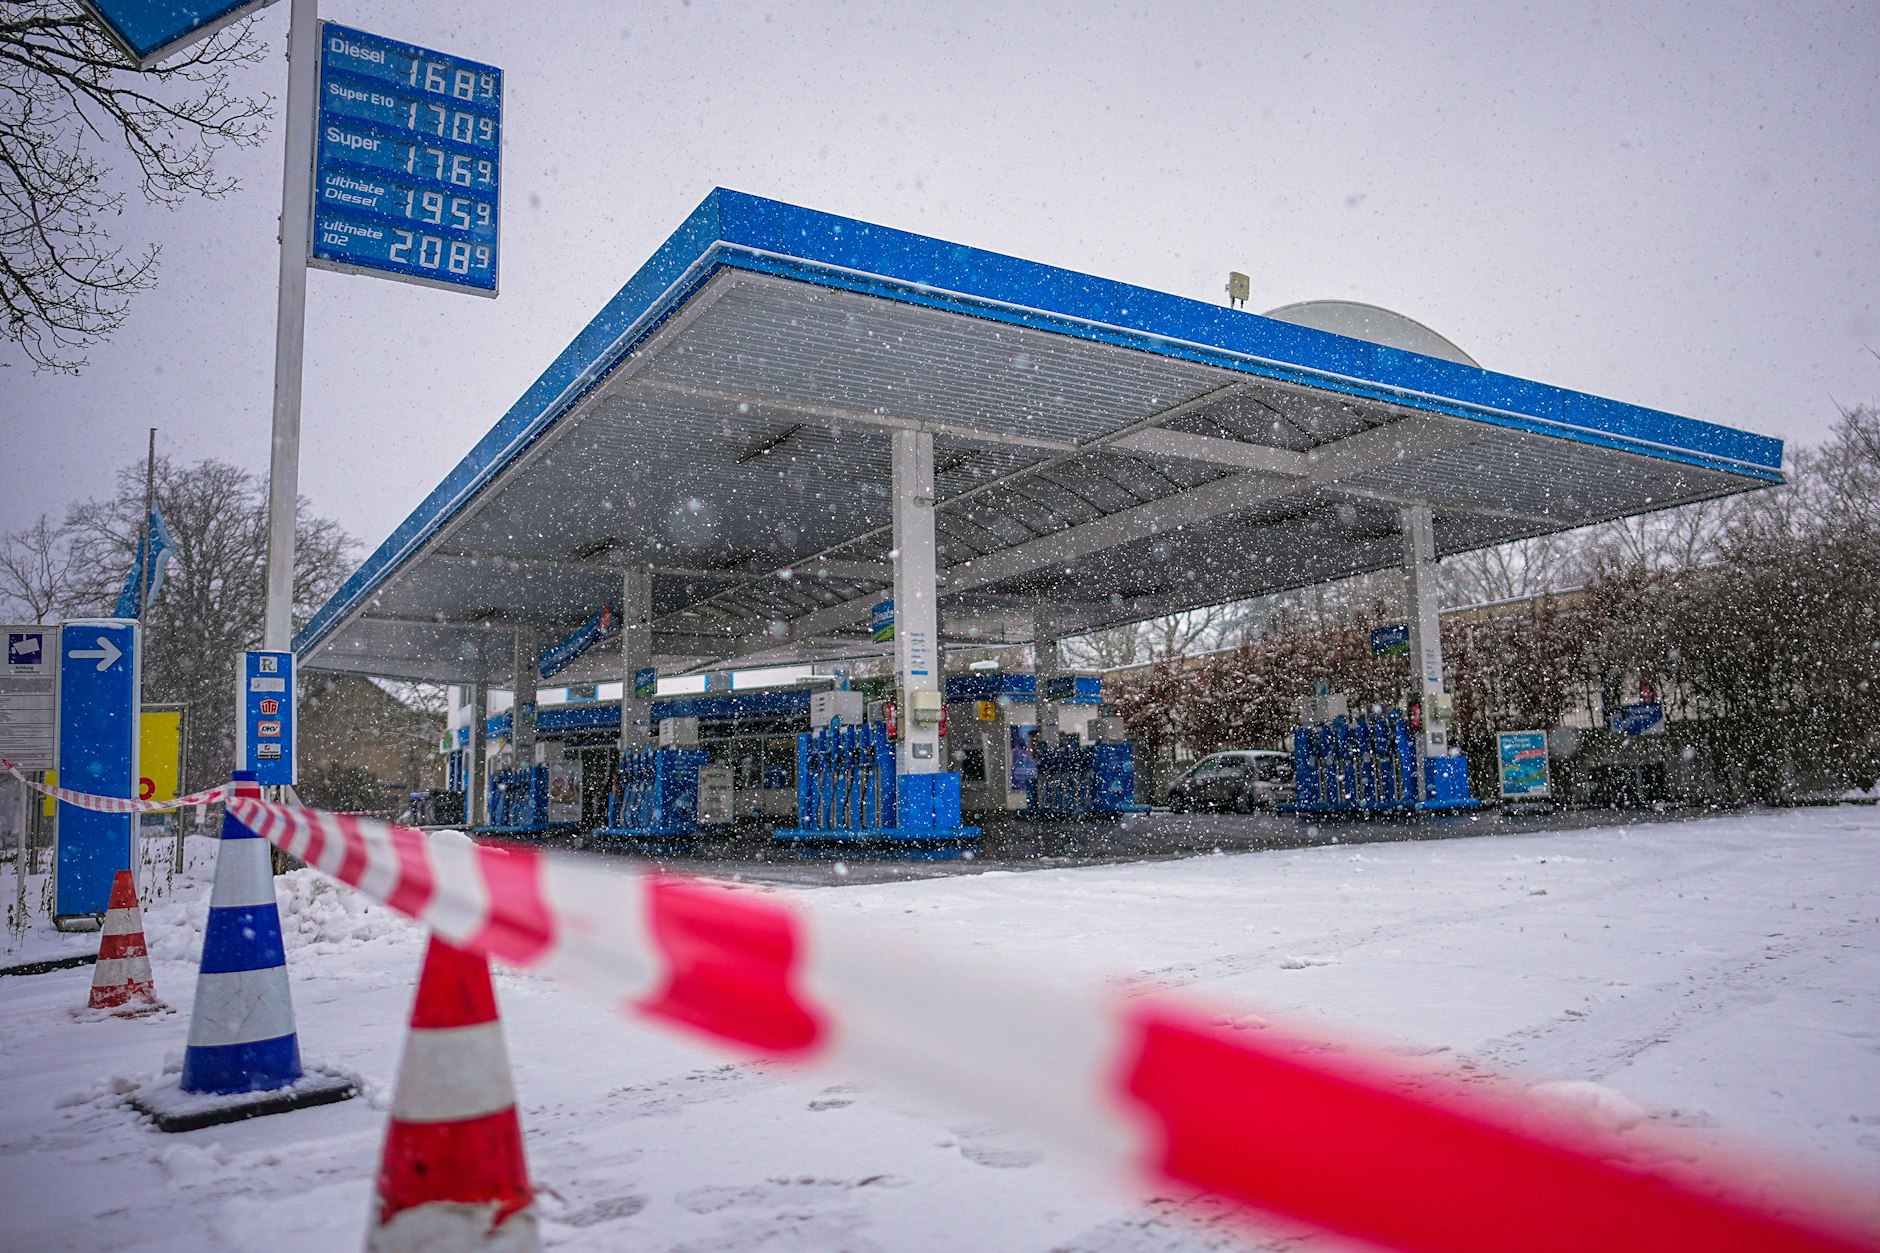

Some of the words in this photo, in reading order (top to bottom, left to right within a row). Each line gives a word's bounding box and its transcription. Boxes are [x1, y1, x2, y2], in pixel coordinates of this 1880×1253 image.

[331, 37, 385, 65] Diesel
[330, 84, 370, 101] Super
[371, 94, 394, 108] E10
[327, 128, 380, 151] Super
[325, 177, 385, 196] ultimate
[325, 188, 377, 208] Diesel
[322, 232, 349, 247] 102
[323, 221, 383, 241] ultimate
